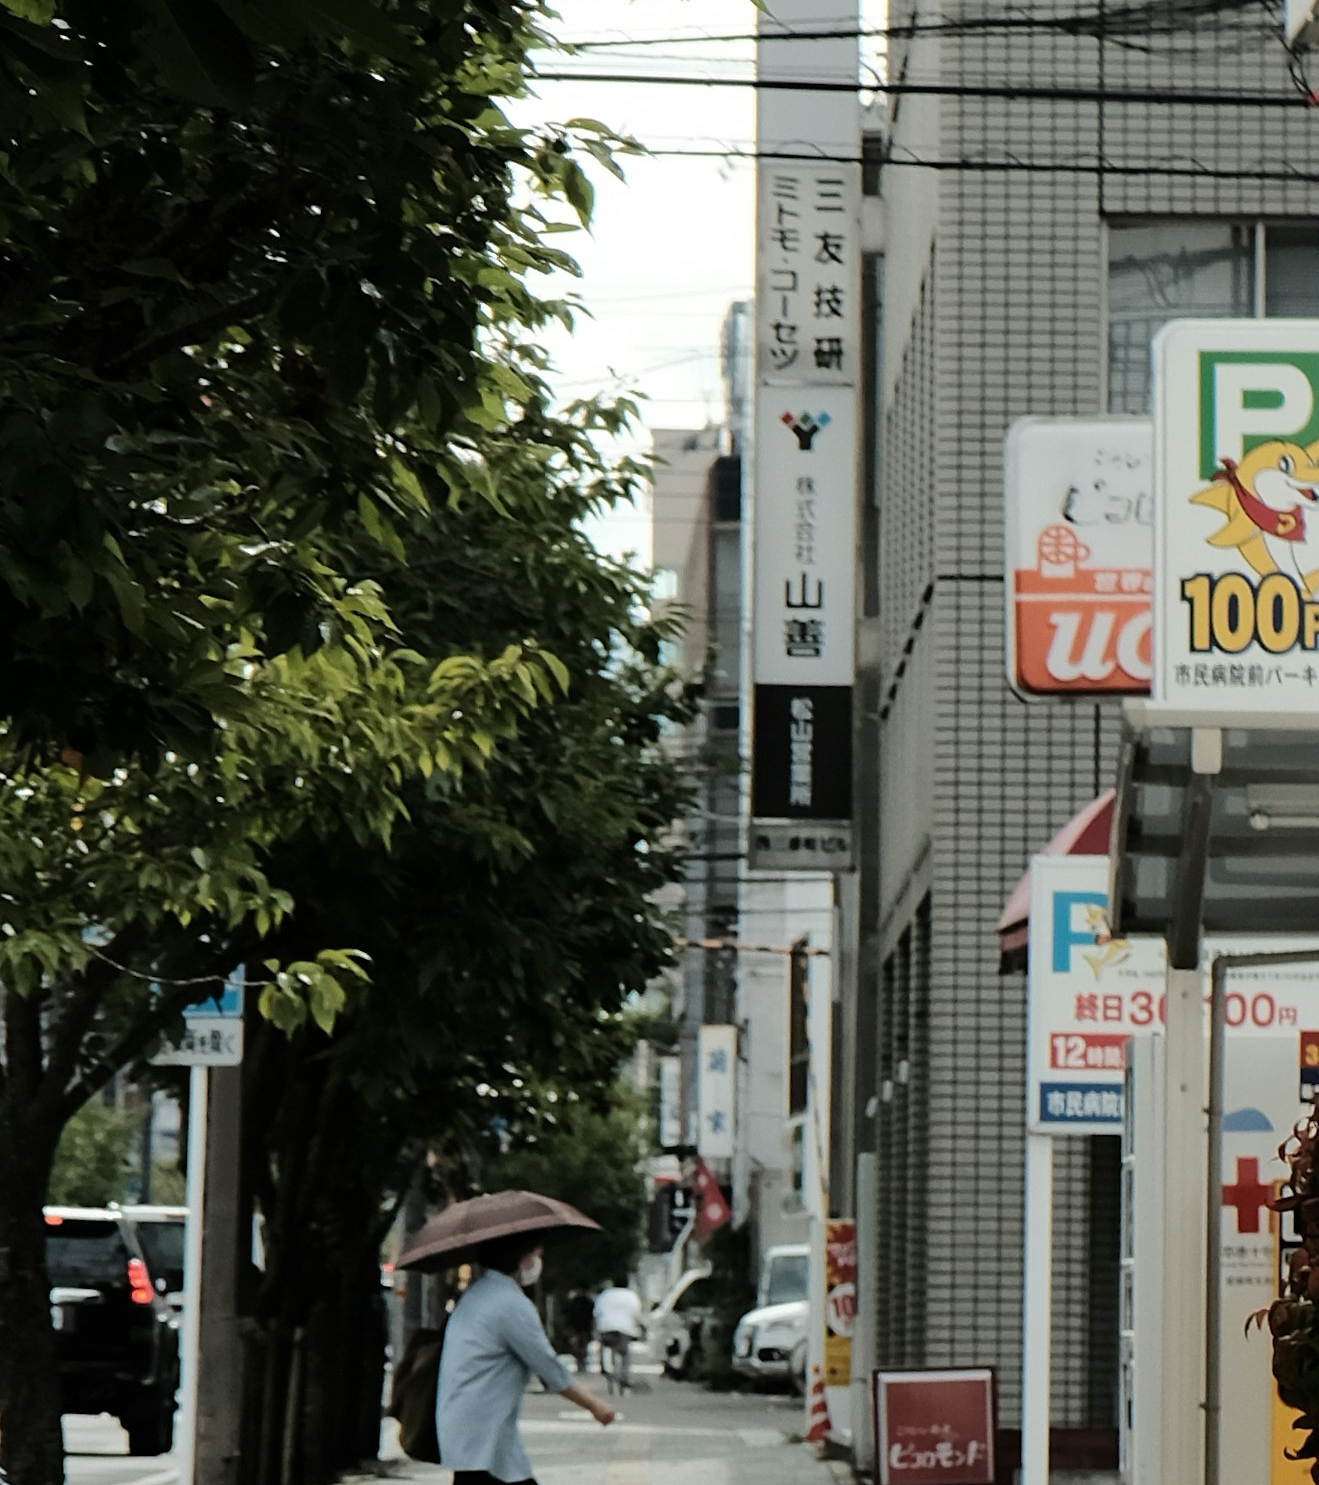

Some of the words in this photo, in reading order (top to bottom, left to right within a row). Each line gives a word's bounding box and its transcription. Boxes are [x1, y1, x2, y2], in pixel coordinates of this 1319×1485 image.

[814, 179, 845, 372] 三友技研
[785, 571, 824, 658] 山善
[1047, 1090, 1125, 1117] 市民病院
